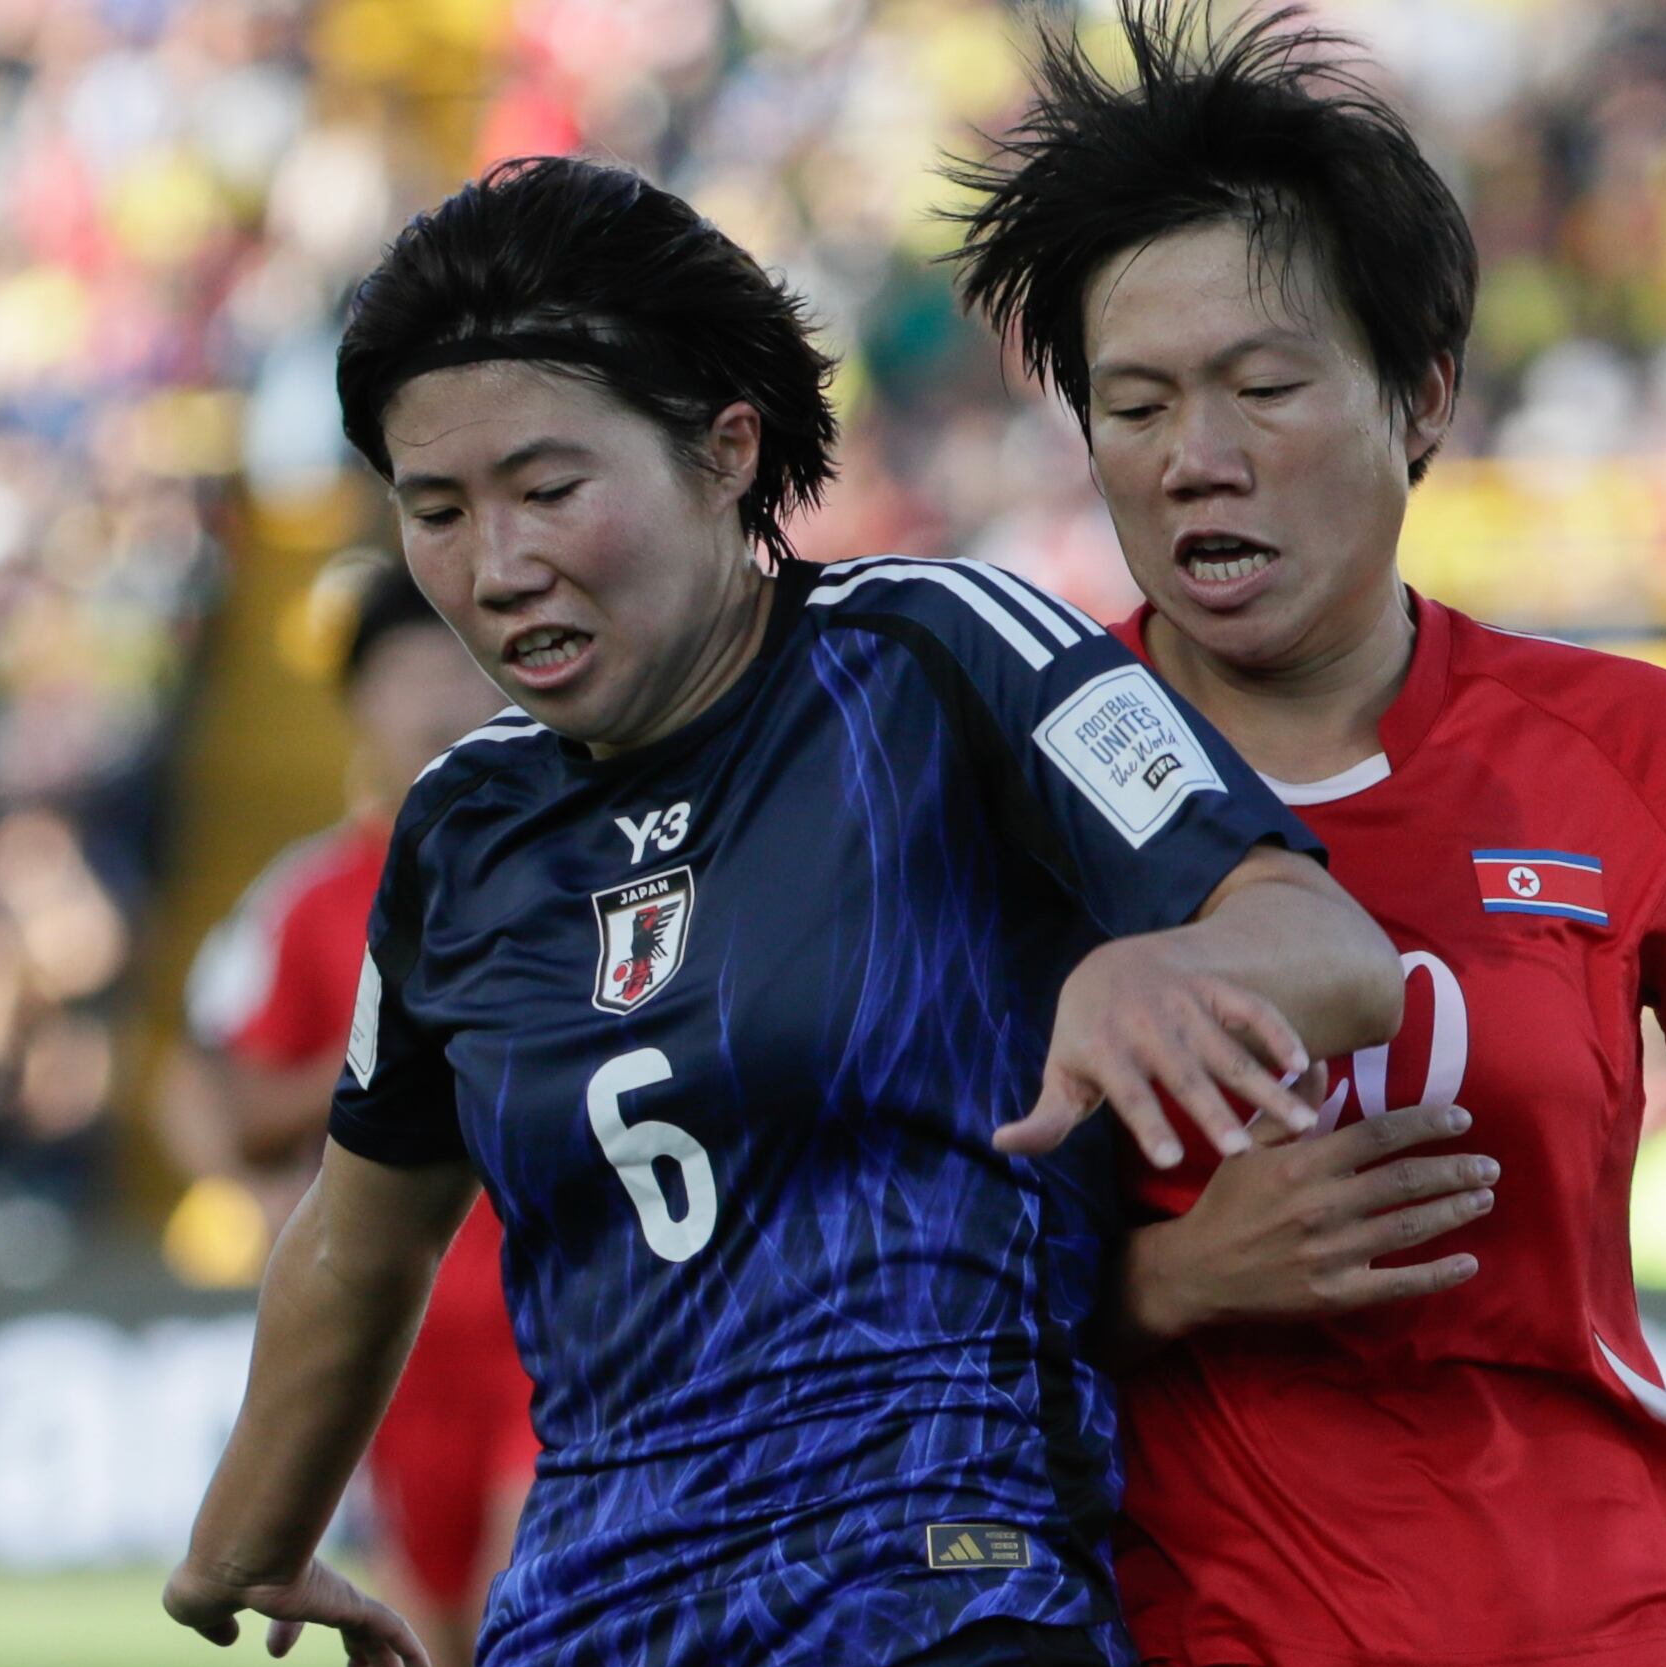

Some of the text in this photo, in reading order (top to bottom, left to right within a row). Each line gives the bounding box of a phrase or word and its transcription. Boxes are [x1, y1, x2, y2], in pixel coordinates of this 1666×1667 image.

[1076, 692, 1145, 745] FOOTBALL
[1090, 706, 1161, 765] UNITES
[1109, 728, 1179, 788] the World
[1146, 754, 1180, 788] FIFA
[615, 801, 692, 864] Y-3
[620, 880, 670, 906] JAPAN
[587, 1047, 718, 1263] 6
